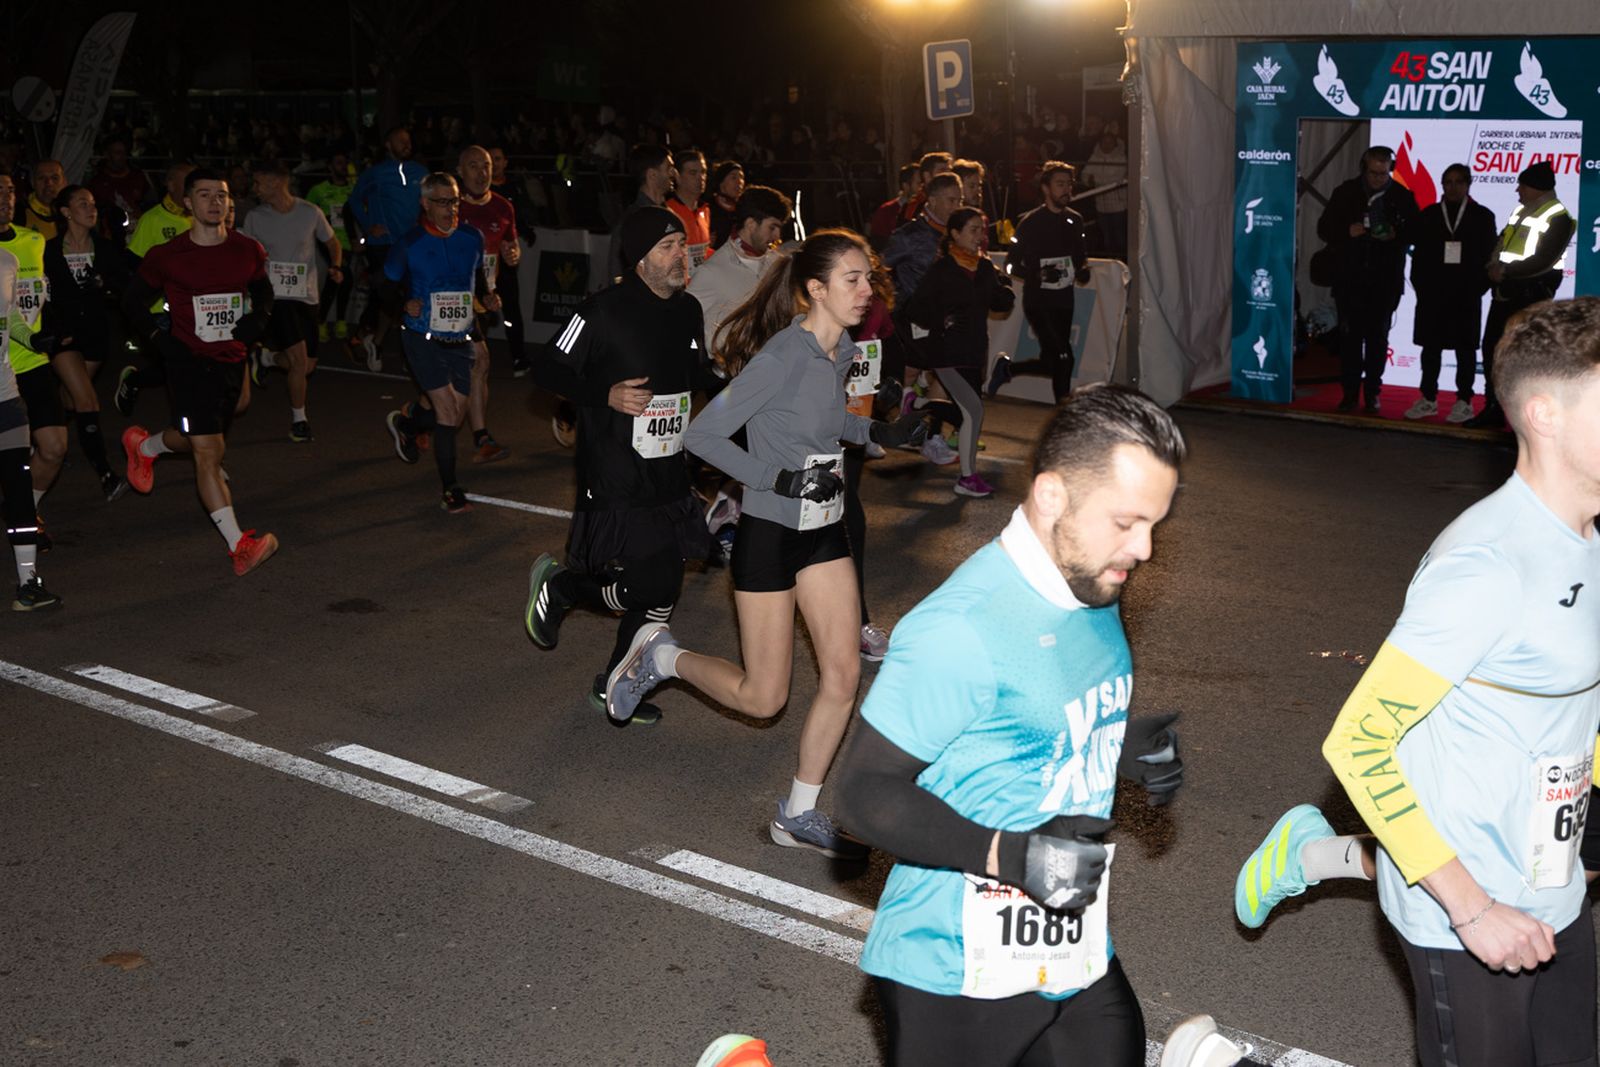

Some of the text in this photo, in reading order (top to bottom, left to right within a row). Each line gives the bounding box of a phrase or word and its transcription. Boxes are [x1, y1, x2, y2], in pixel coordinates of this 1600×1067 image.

[1391, 51, 1493, 81] 43 SAN
[553, 62, 588, 87] WC
[935, 50, 964, 110] P
[1326, 84, 1344, 105] 43
[1379, 78, 1485, 111] ANTÓN
[1529, 84, 1550, 106] 43
[1479, 130, 1514, 138] CARRERA
[1516, 131, 1547, 139] URBANA
[1477, 141, 1526, 151] NOCHE DE
[1238, 150, 1291, 160] calderón
[1473, 151, 1523, 173] SAN
[1479, 175, 1489, 183] DE
[1490, 175, 1516, 184] ENERO
[280, 274, 298, 285] 739
[206, 310, 235, 326] 2193
[439, 306, 468, 319] 6363
[651, 401, 670, 409] NOCHE
[647, 416, 683, 437] 4043
[1348, 697, 1420, 823] ITÁLICA
[1545, 787, 1573, 802] SAN
[1011, 951, 1046, 961] Antonio
